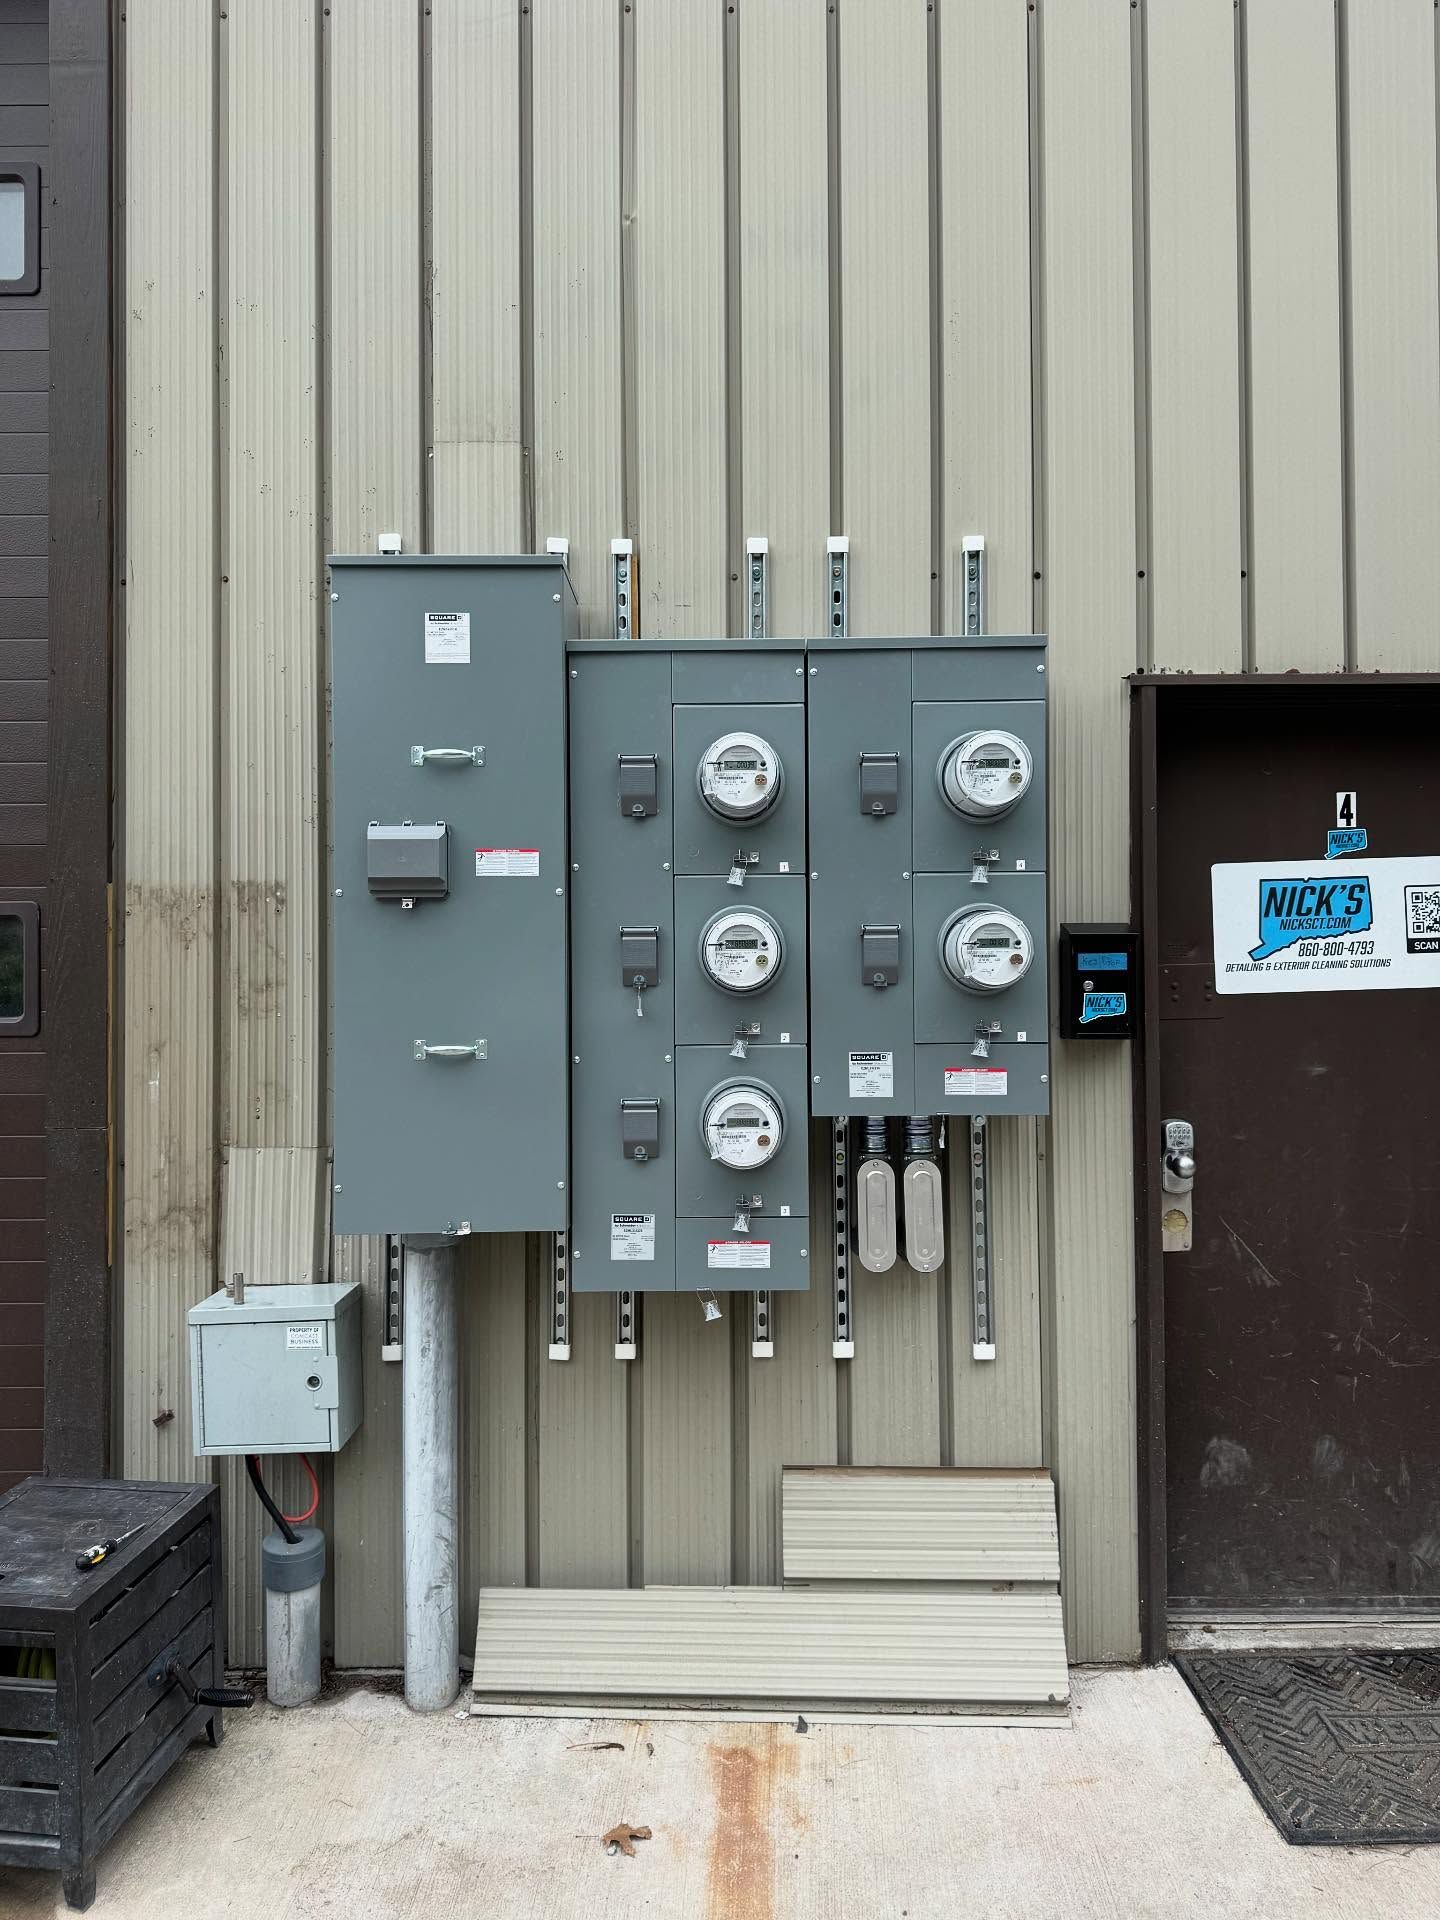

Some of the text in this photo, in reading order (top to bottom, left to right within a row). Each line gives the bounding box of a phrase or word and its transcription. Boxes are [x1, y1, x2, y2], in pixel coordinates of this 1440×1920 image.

[1339, 793, 1354, 826] 4
[1330, 832, 1363, 845] NICK'S
[1263, 884, 1366, 918] NICK'S
[1279, 917, 1352, 931] NICKSCT.COM
[1298, 941, 1375, 957] 860-800-4793
[1414, 941, 1439, 950] SCAN
[1225, 958, 1392, 973] DETAILING & EXTERIOR CLEANING SOLUTIONS
[1087, 996, 1122, 1008] NICK'S
